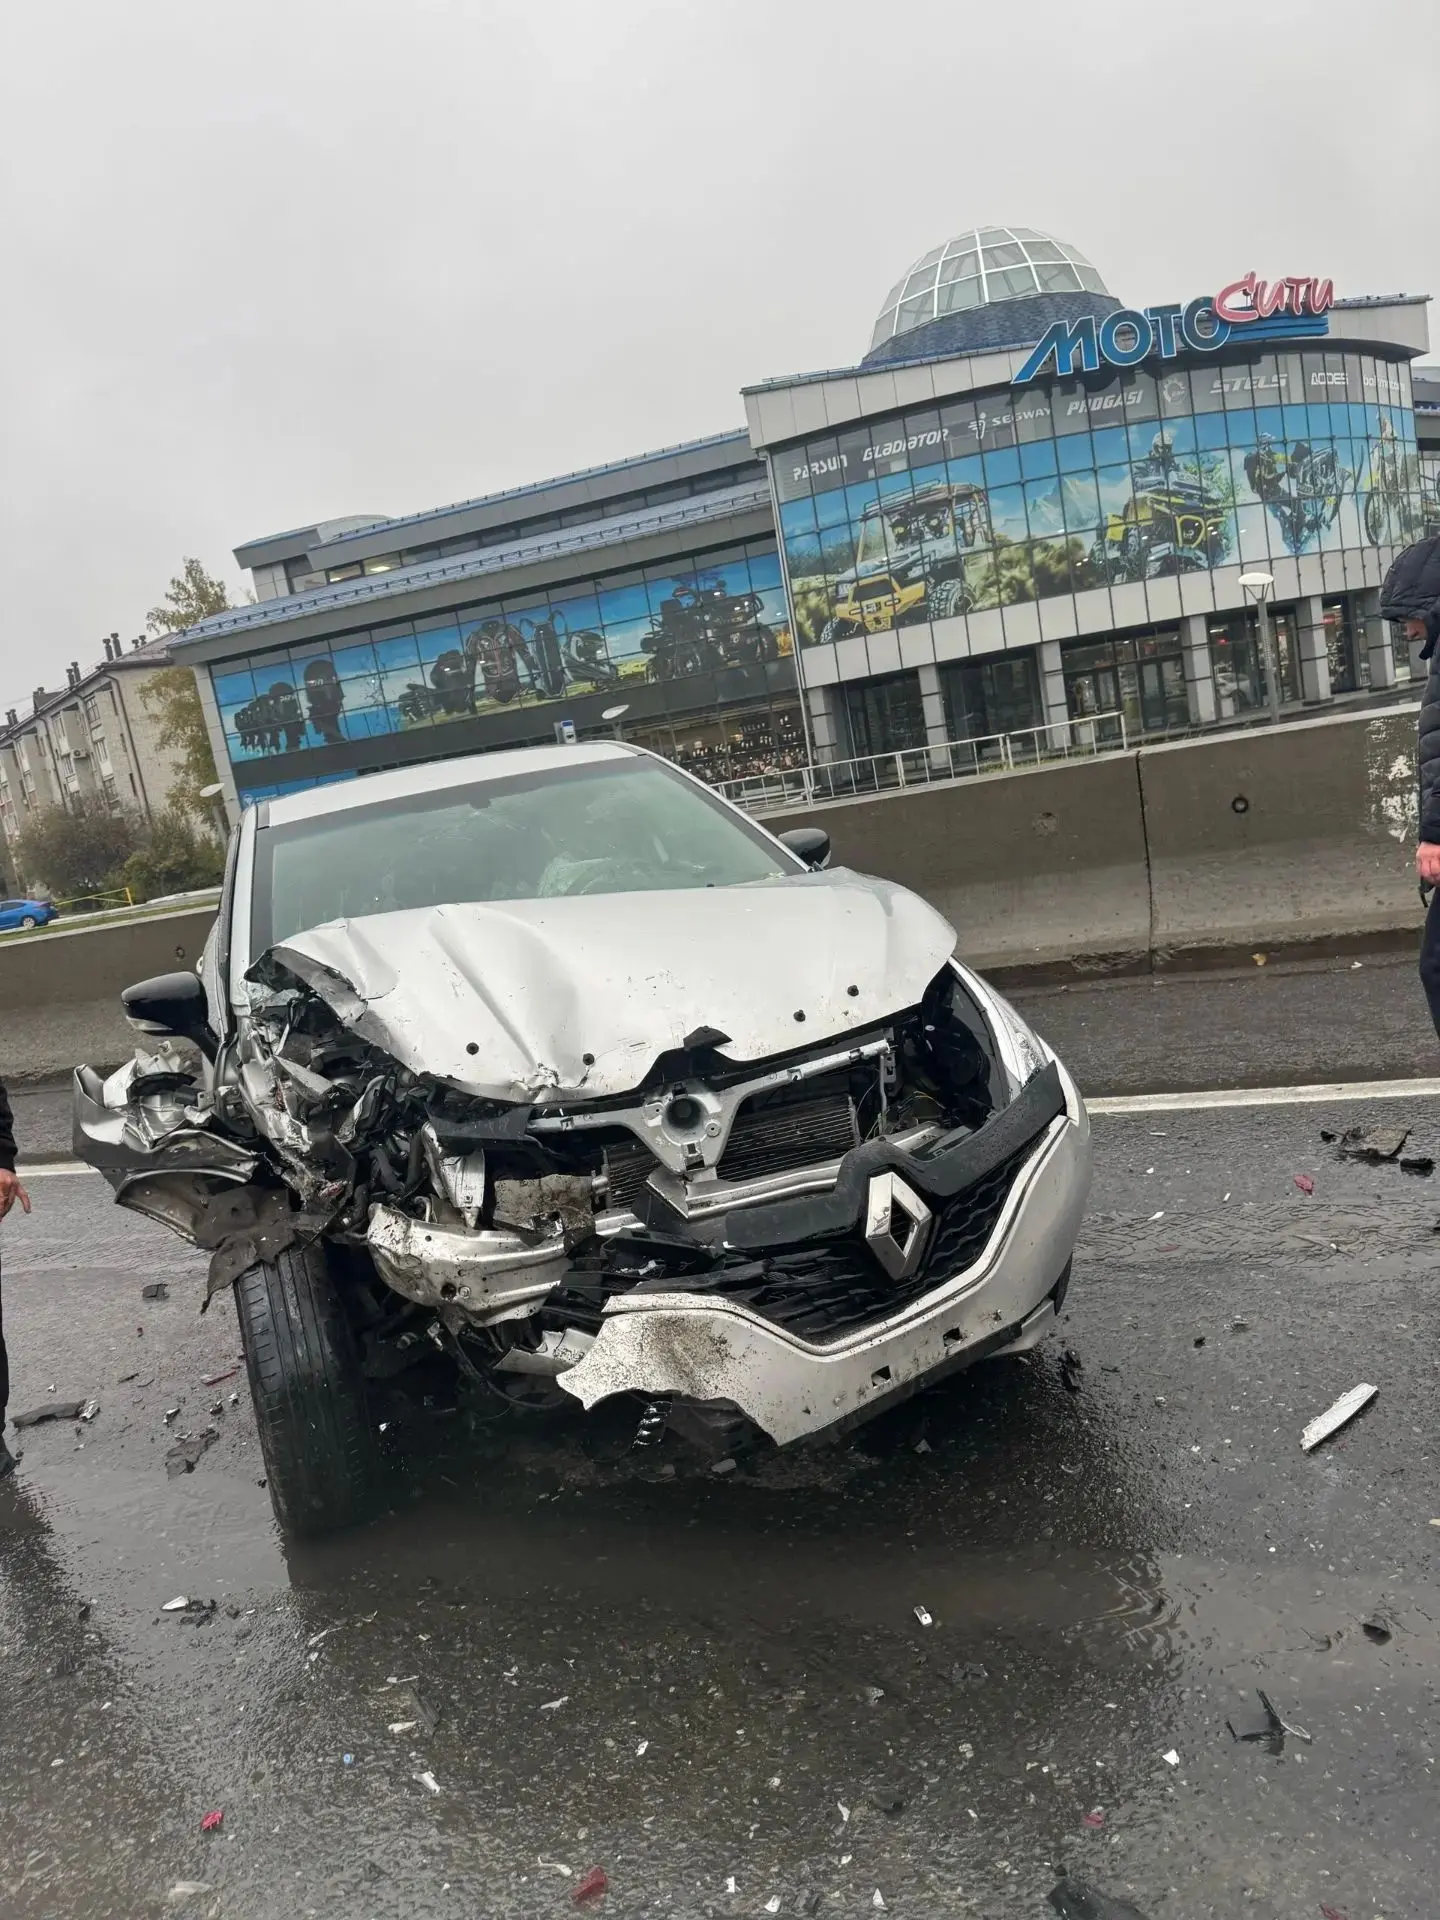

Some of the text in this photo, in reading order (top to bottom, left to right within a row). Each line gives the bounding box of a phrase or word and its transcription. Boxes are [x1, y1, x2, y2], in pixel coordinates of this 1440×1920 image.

[1010, 295, 1231, 385] МОТО
[1209, 373, 1288, 394] STELS
[991, 407, 1051, 426] SEGWAY
[793, 454, 848, 482] PARSUN
